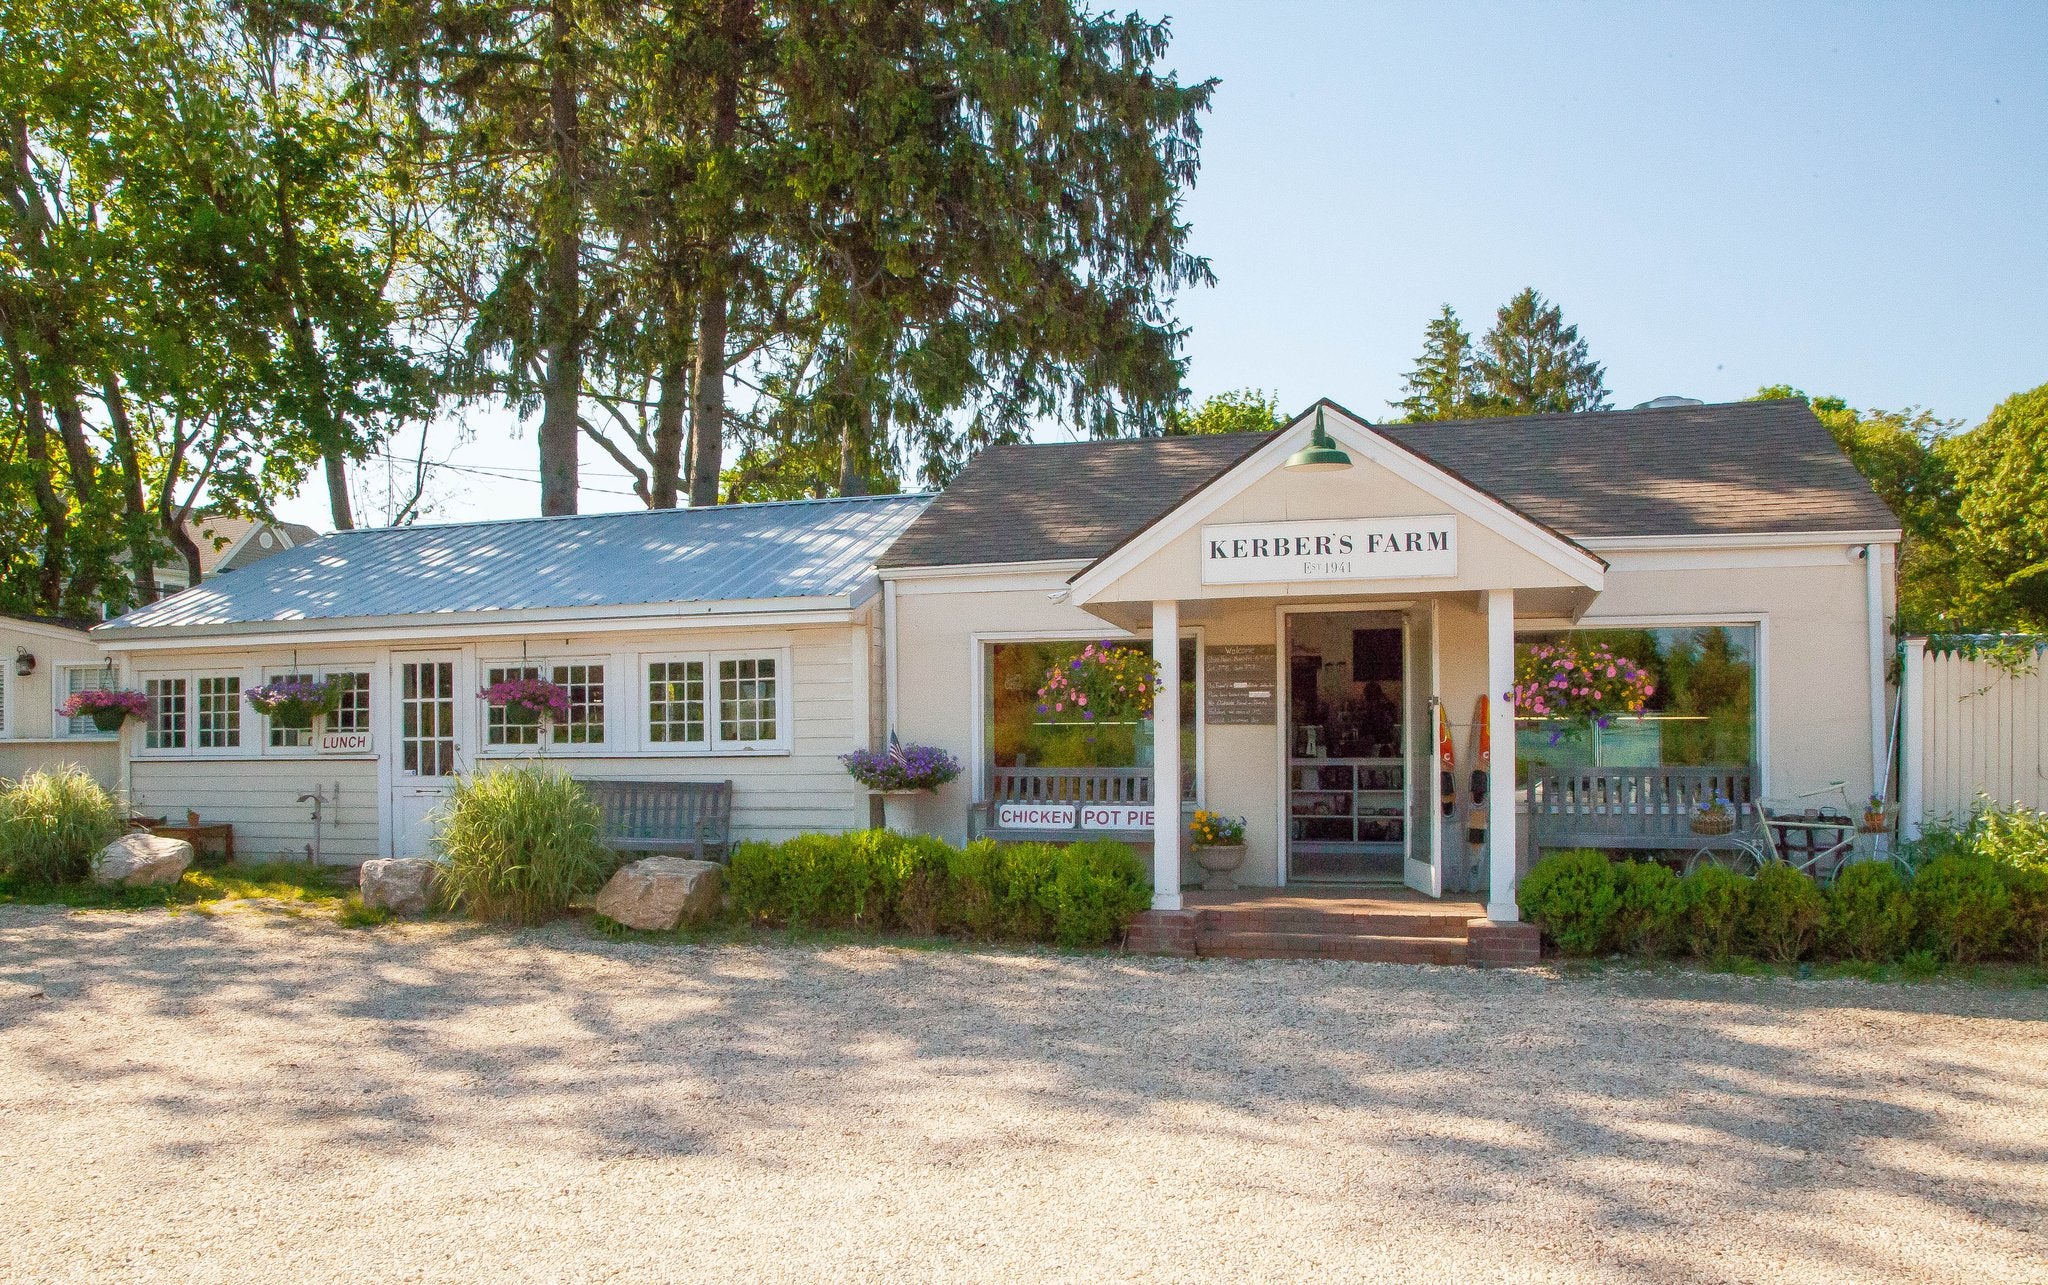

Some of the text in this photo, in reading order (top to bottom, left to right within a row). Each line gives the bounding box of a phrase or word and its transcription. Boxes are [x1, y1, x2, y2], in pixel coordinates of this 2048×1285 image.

[1209, 531, 1449, 559] KERBER'S FARM
[1324, 561, 1352, 574] 1941
[1225, 646, 1255, 654] Welcome
[323, 736, 366, 749] LUNCH
[1001, 810, 1073, 824] CHICKEN
[1084, 810, 1154, 826] POT PIE
